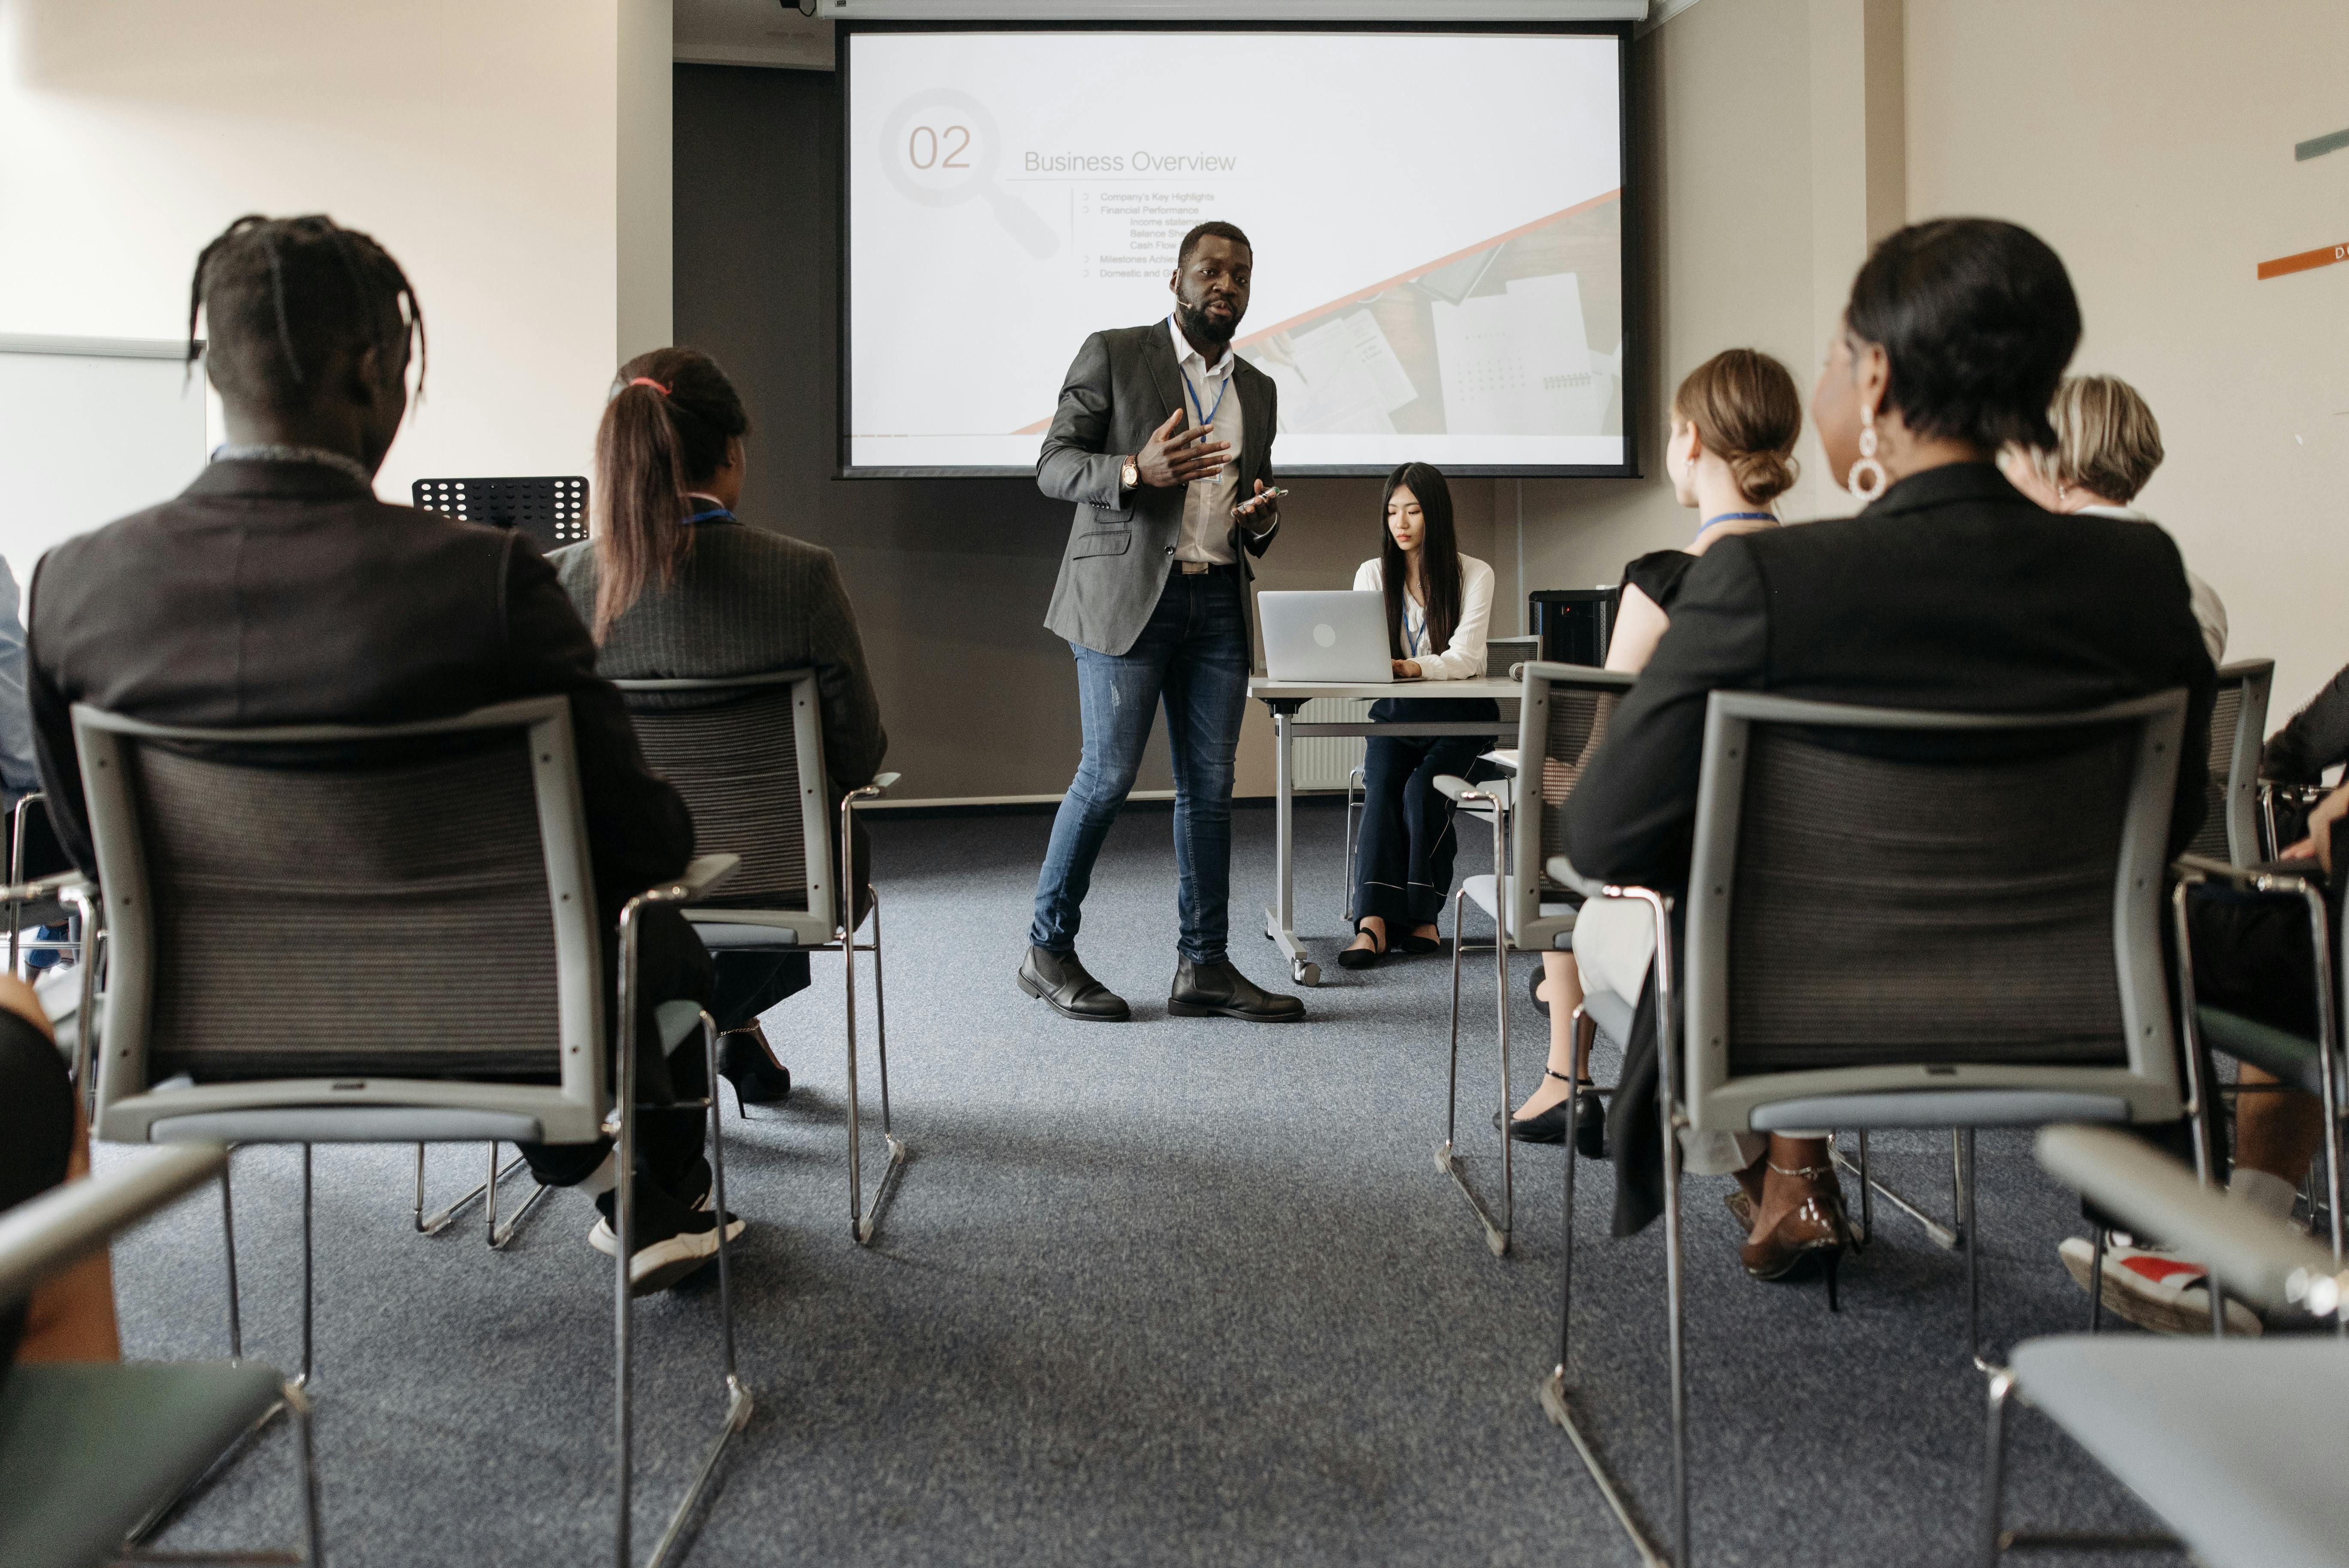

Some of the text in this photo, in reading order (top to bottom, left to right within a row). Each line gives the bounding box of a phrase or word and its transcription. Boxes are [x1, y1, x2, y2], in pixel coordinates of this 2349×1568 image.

[909, 125, 970, 170] 02
[1025, 151, 1237, 172] Business Overview
[1100, 192, 1215, 203] Company's Key Highlights
[1100, 206, 1199, 215] Financial Performance
[1130, 218, 1163, 226] Income
[1130, 229, 1188, 238] Balance She
[1130, 241, 1154, 250] Cash
[1156, 241, 1177, 250] Flow
[1099, 255, 1147, 264] Milestones
[1099, 269, 1141, 278] Domestic
[1143, 269, 1161, 278] and
